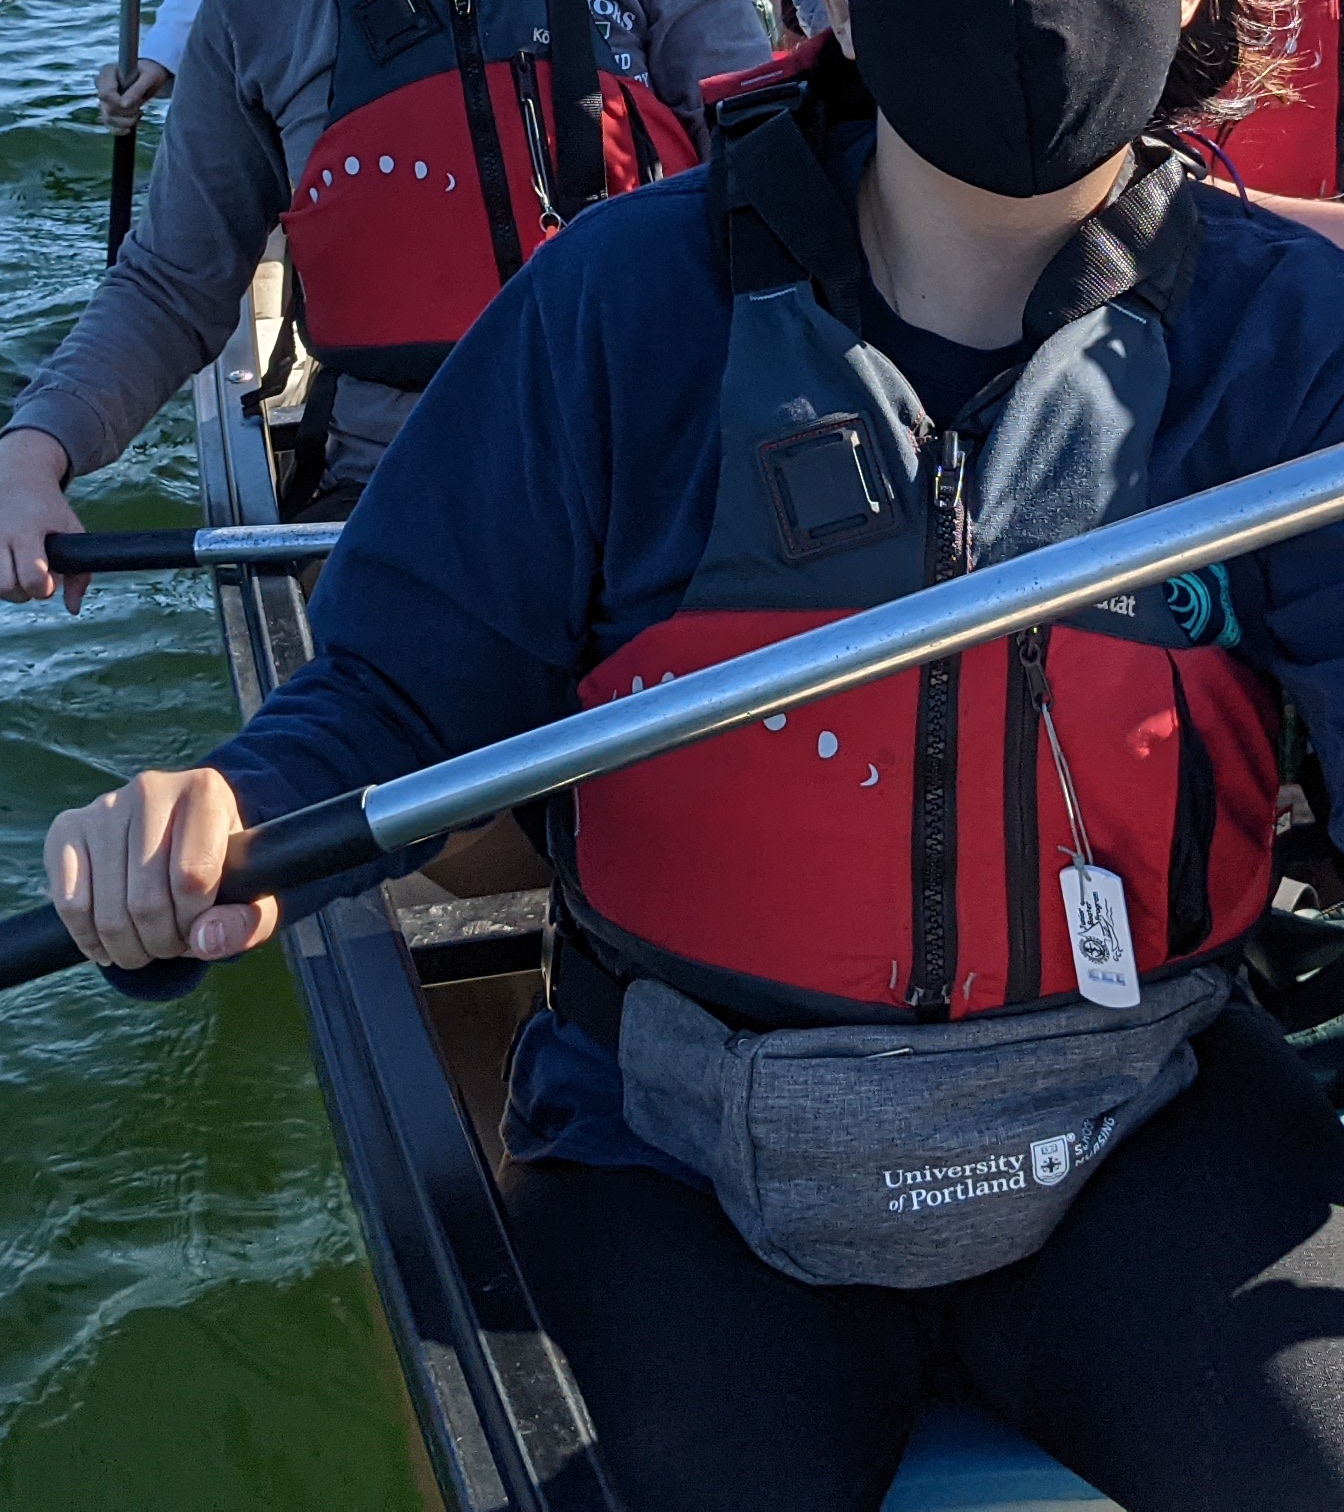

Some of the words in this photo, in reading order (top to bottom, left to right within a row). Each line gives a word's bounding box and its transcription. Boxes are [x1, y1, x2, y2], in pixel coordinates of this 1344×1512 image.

[883, 1154, 1025, 1188] University
[889, 1194, 907, 1212] of
[909, 1171, 1027, 1210] Portland
